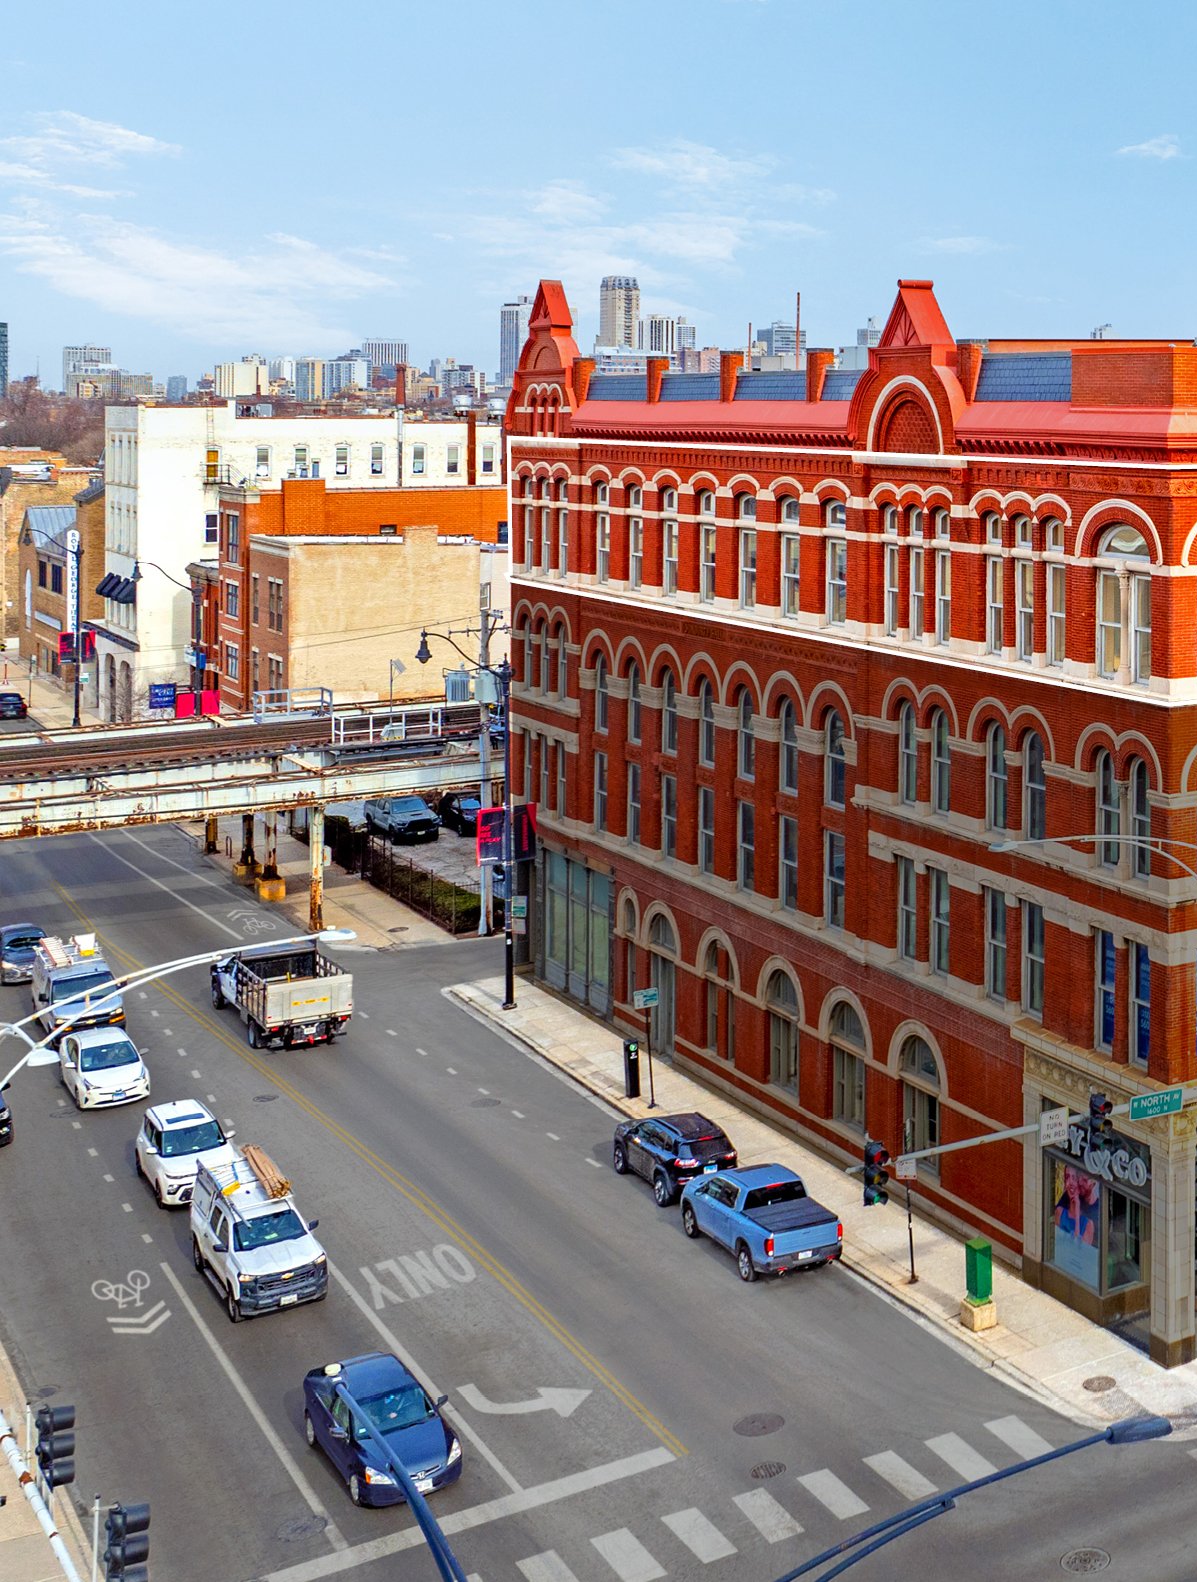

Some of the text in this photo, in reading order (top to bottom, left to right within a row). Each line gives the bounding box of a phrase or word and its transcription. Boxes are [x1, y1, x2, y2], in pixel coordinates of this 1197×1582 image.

[1140, 1093, 1171, 1108] NORTH
[1147, 1104, 1168, 1115] 1600 N
[1046, 1121, 1063, 1131] TURN
[1042, 1129, 1066, 1141] ON RED
[359, 1243, 476, 1310] ONLY
